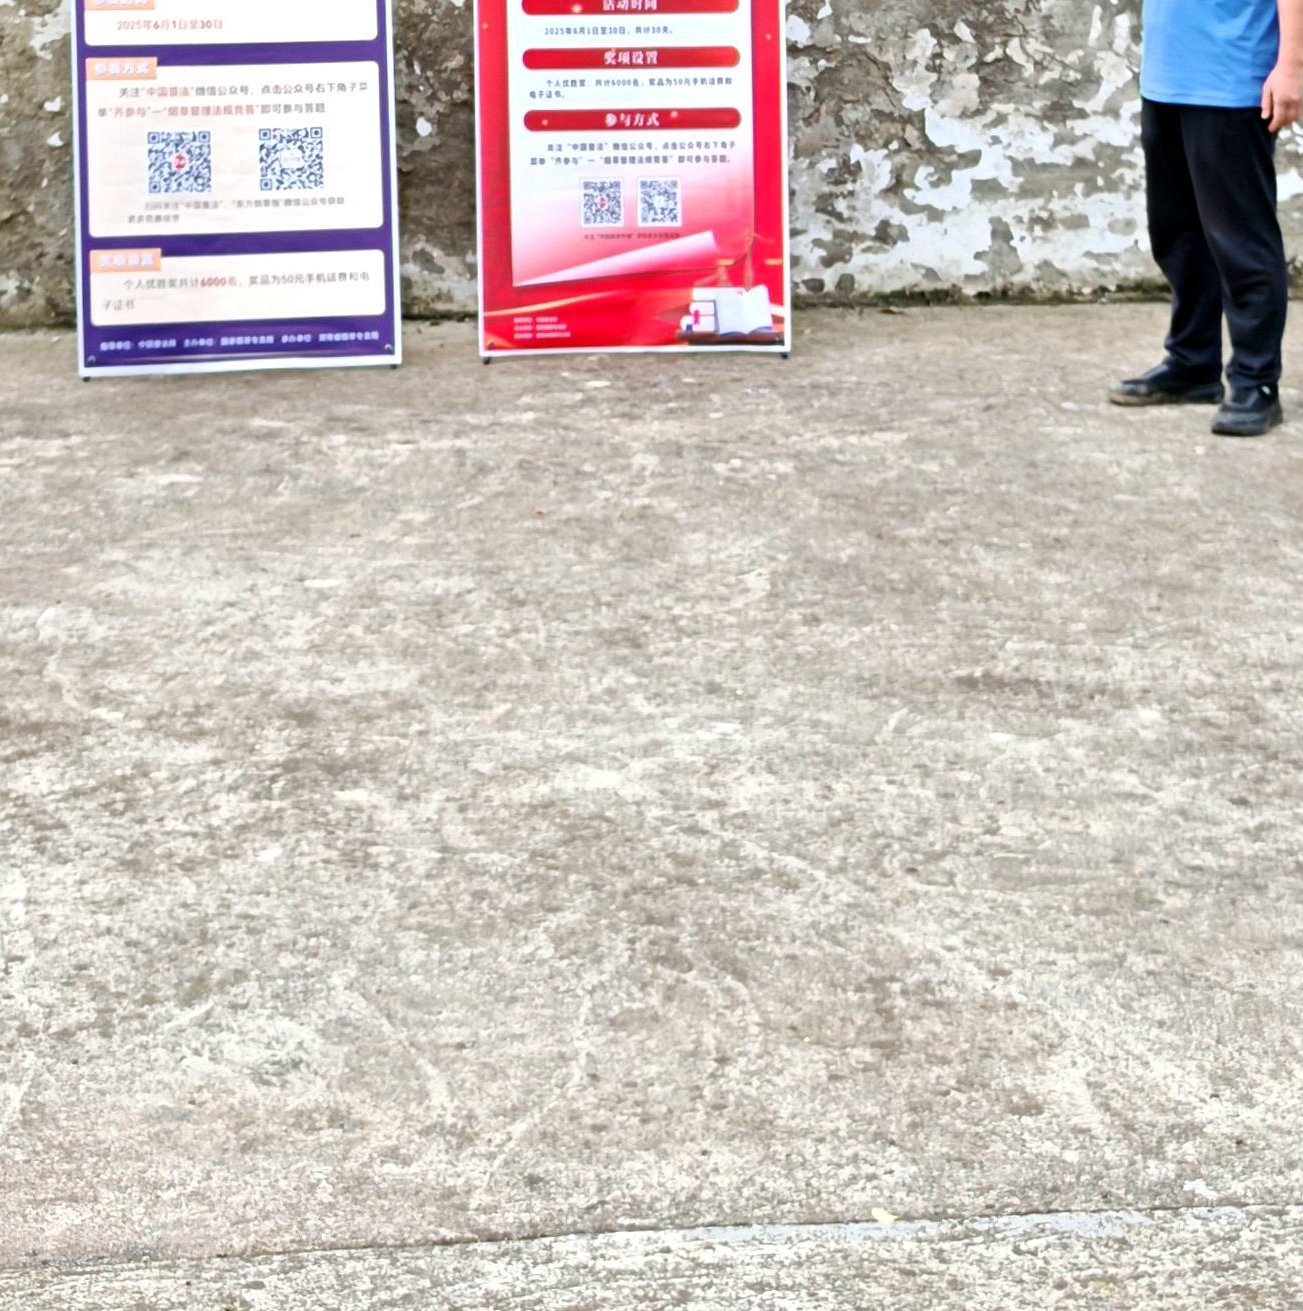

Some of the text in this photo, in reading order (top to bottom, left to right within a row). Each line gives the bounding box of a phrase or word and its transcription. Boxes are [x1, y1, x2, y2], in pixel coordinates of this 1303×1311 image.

[604, 51, 658, 65] 奖项设置
[605, 112, 660, 127] 参与方式
